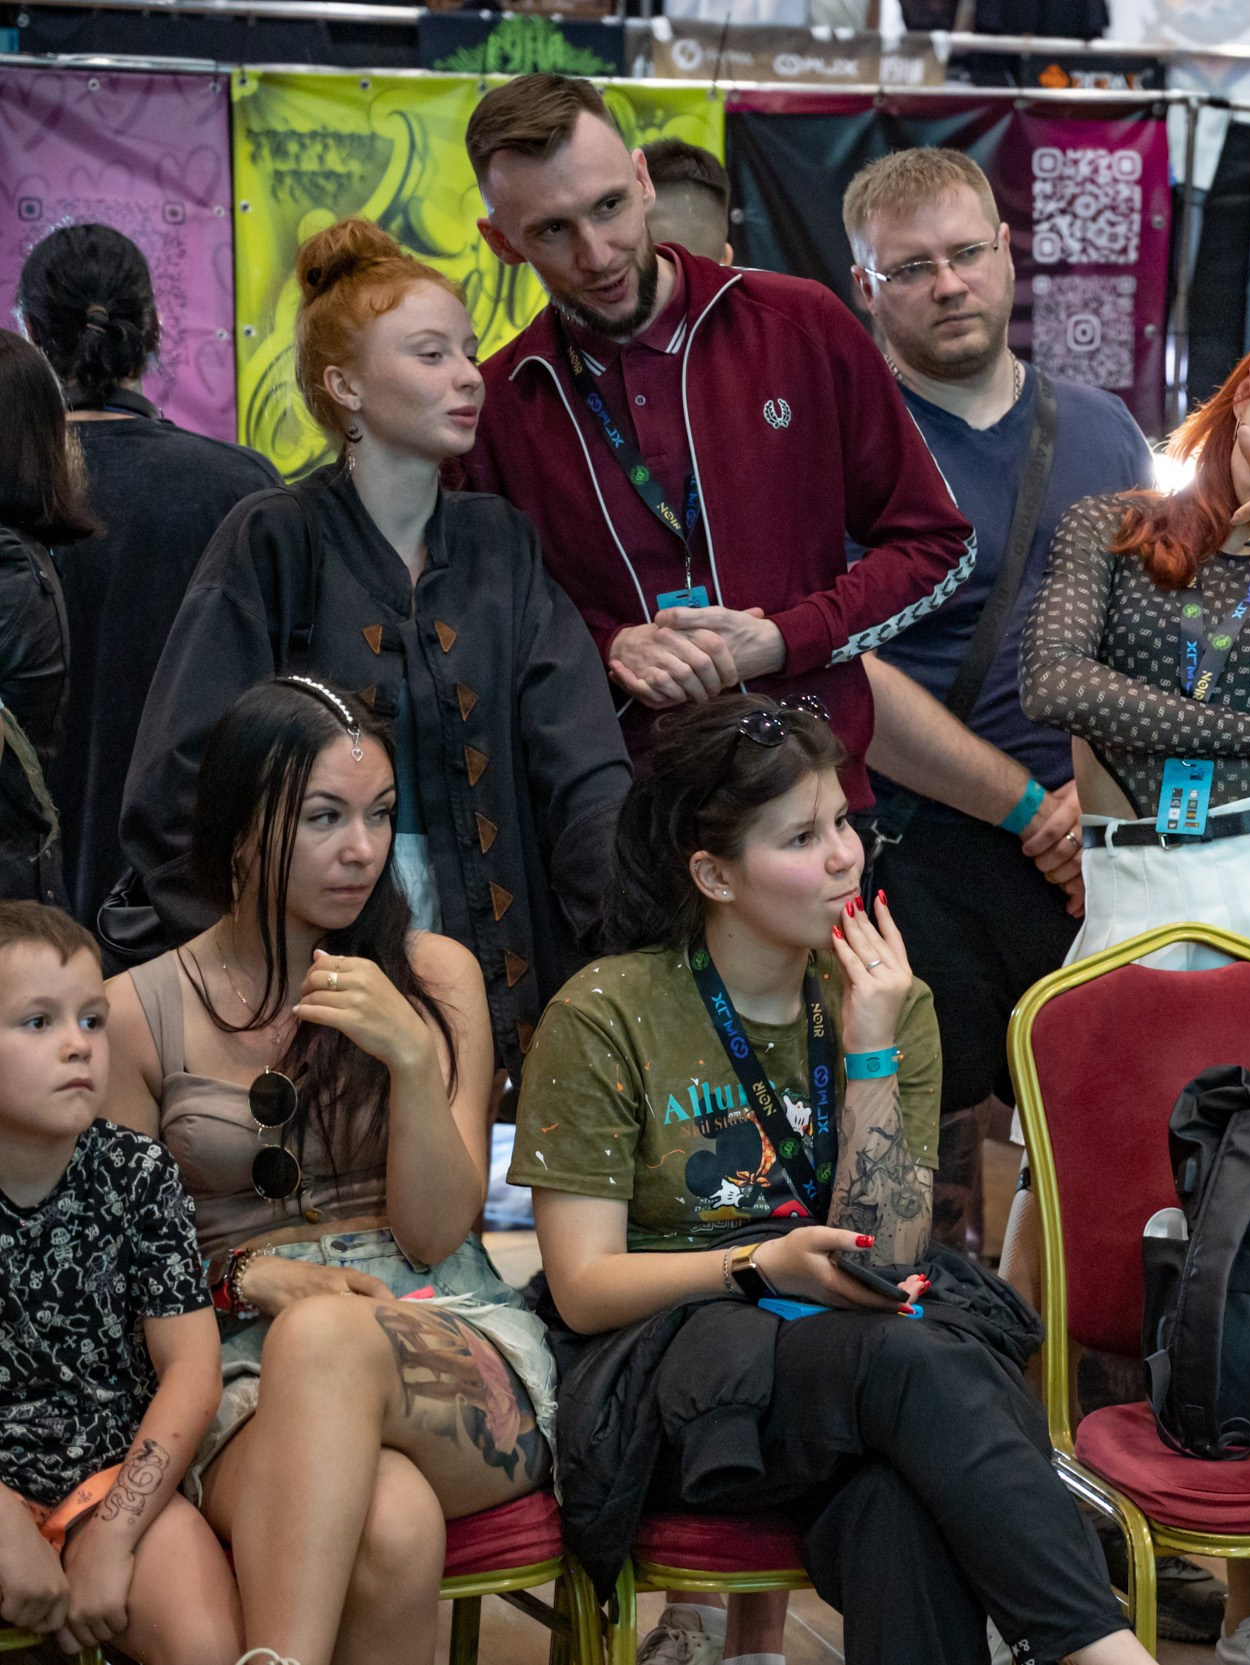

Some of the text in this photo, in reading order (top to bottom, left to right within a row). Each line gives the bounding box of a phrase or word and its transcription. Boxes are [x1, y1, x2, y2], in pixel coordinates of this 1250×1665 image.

[656, 501, 683, 531] NOIR
[810, 1002, 825, 1039] NOIR
[752, 1080, 777, 1117] NOIR
